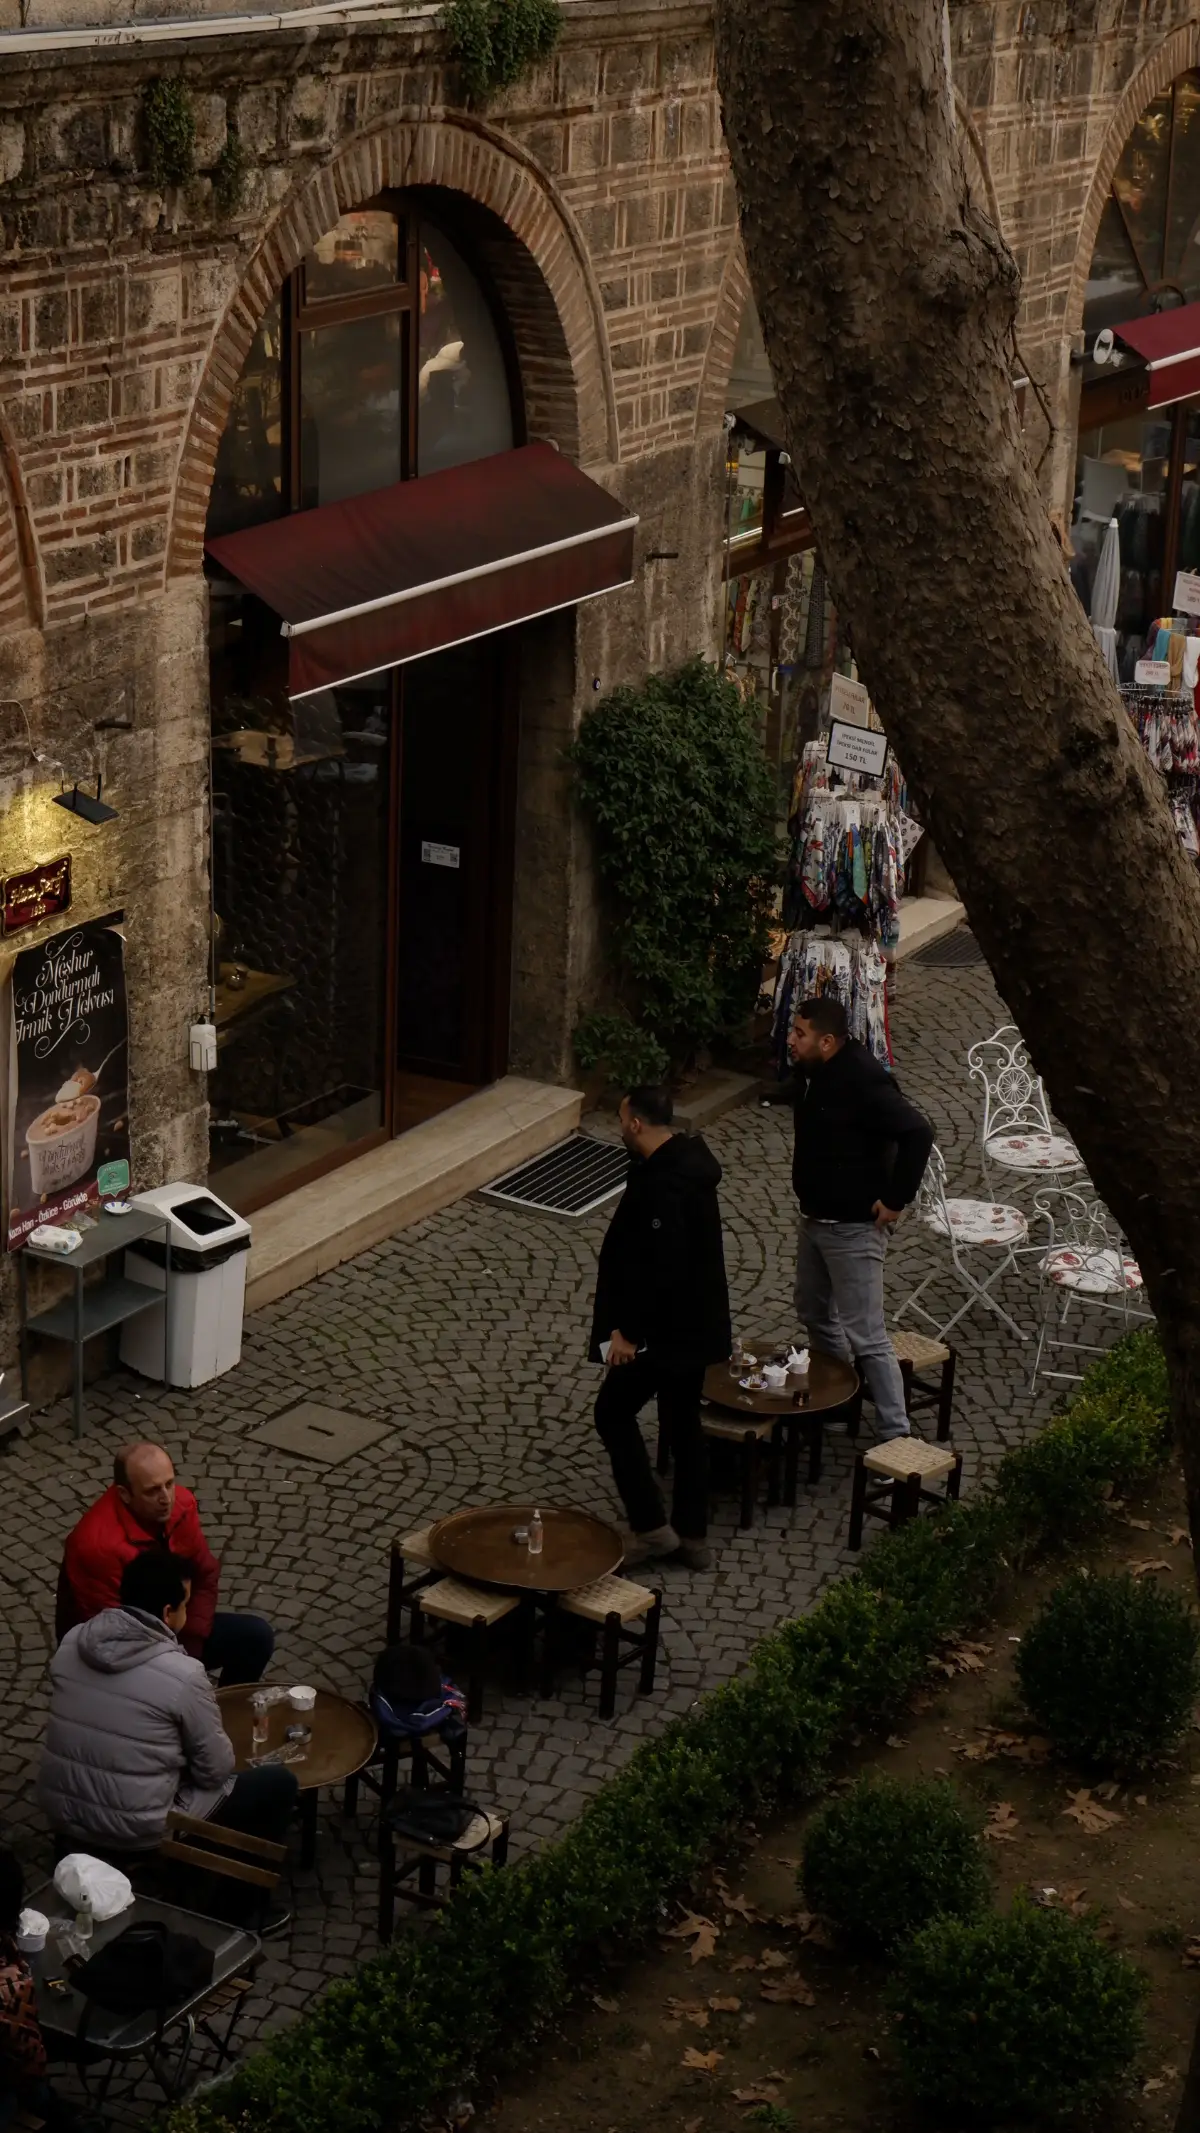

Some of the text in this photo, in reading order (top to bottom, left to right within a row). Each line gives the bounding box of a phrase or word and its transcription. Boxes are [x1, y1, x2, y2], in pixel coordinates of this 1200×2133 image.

[845, 752, 868, 765] 150 TL
[35, 949, 94, 989] Meşhur
[24, 964, 101, 1015] Dondurmalı
[16, 988, 114, 1045] İrmik Helvası
[22, 1219, 34, 1232] Han
